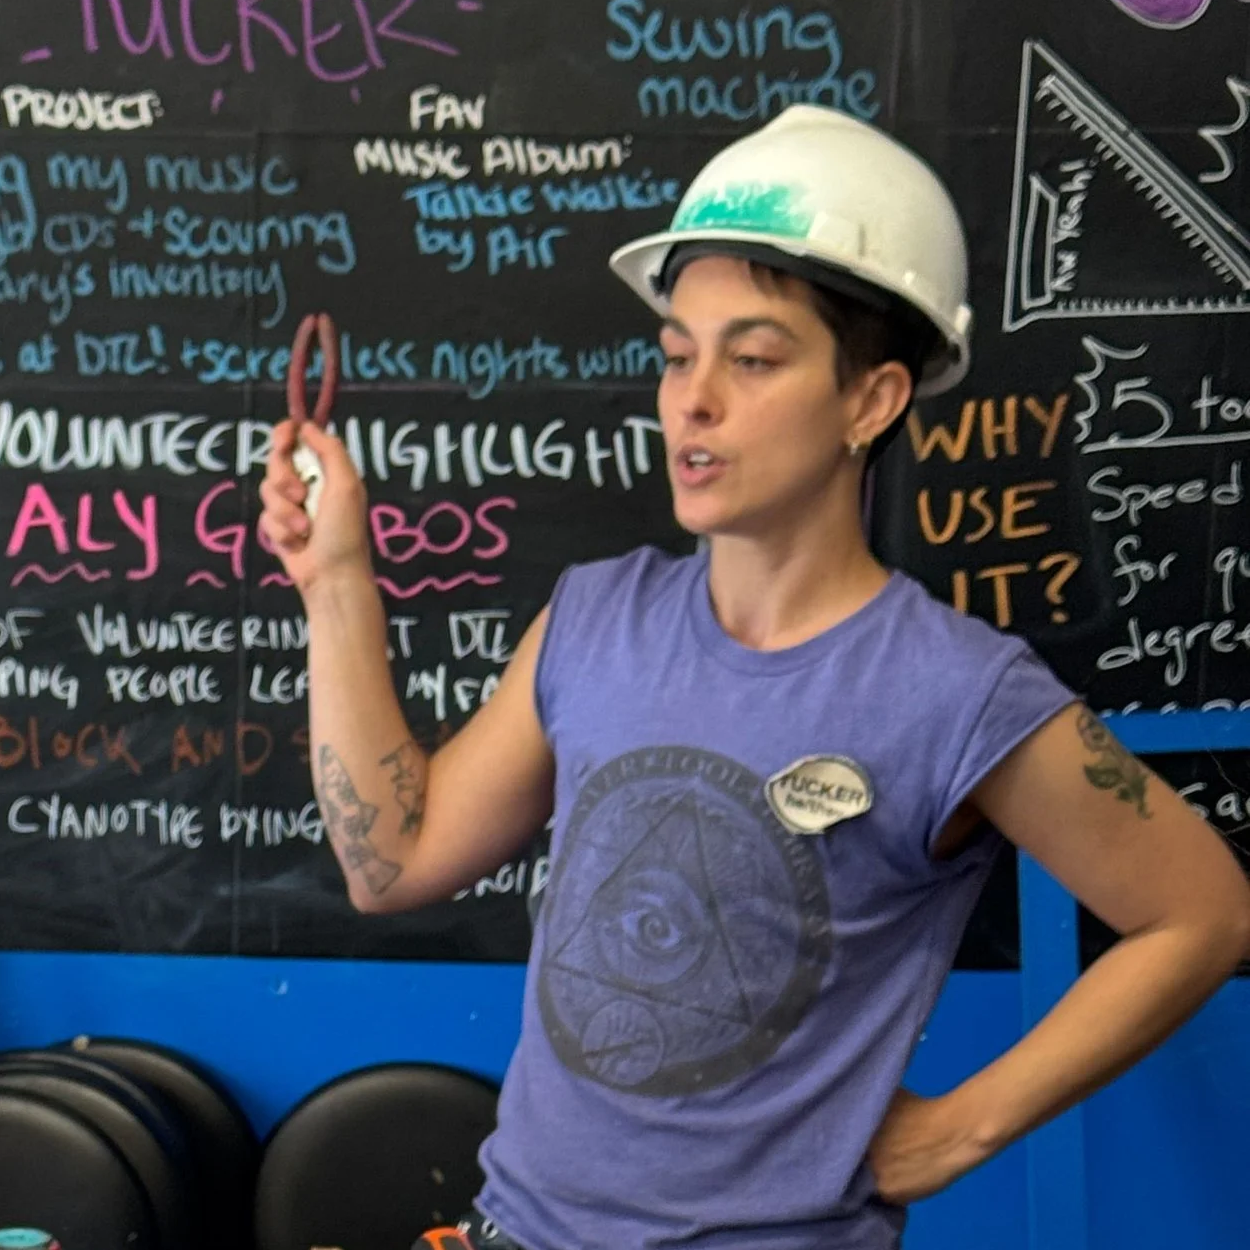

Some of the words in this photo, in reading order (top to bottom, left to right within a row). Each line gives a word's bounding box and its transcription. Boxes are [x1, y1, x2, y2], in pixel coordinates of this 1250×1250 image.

[605, 0, 842, 82] Sewing
[1, 84, 165, 131] PROJECT:
[409, 84, 486, 131] FAV
[47, 152, 128, 214] my
[145, 155, 298, 196] music
[415, 222, 474, 272] by
[487, 222, 570, 275] Air
[17, 332, 58, 374] at
[431, 336, 569, 400] nights
[906, 392, 1073, 463] WHY
[1110, 375, 1175, 445] 5
[916, 481, 1059, 545] USE
[1086, 460, 1243, 527] Speed
[5, 482, 160, 580] ALY
[952, 552, 1083, 628] IT?
[1112, 534, 1179, 607] for
